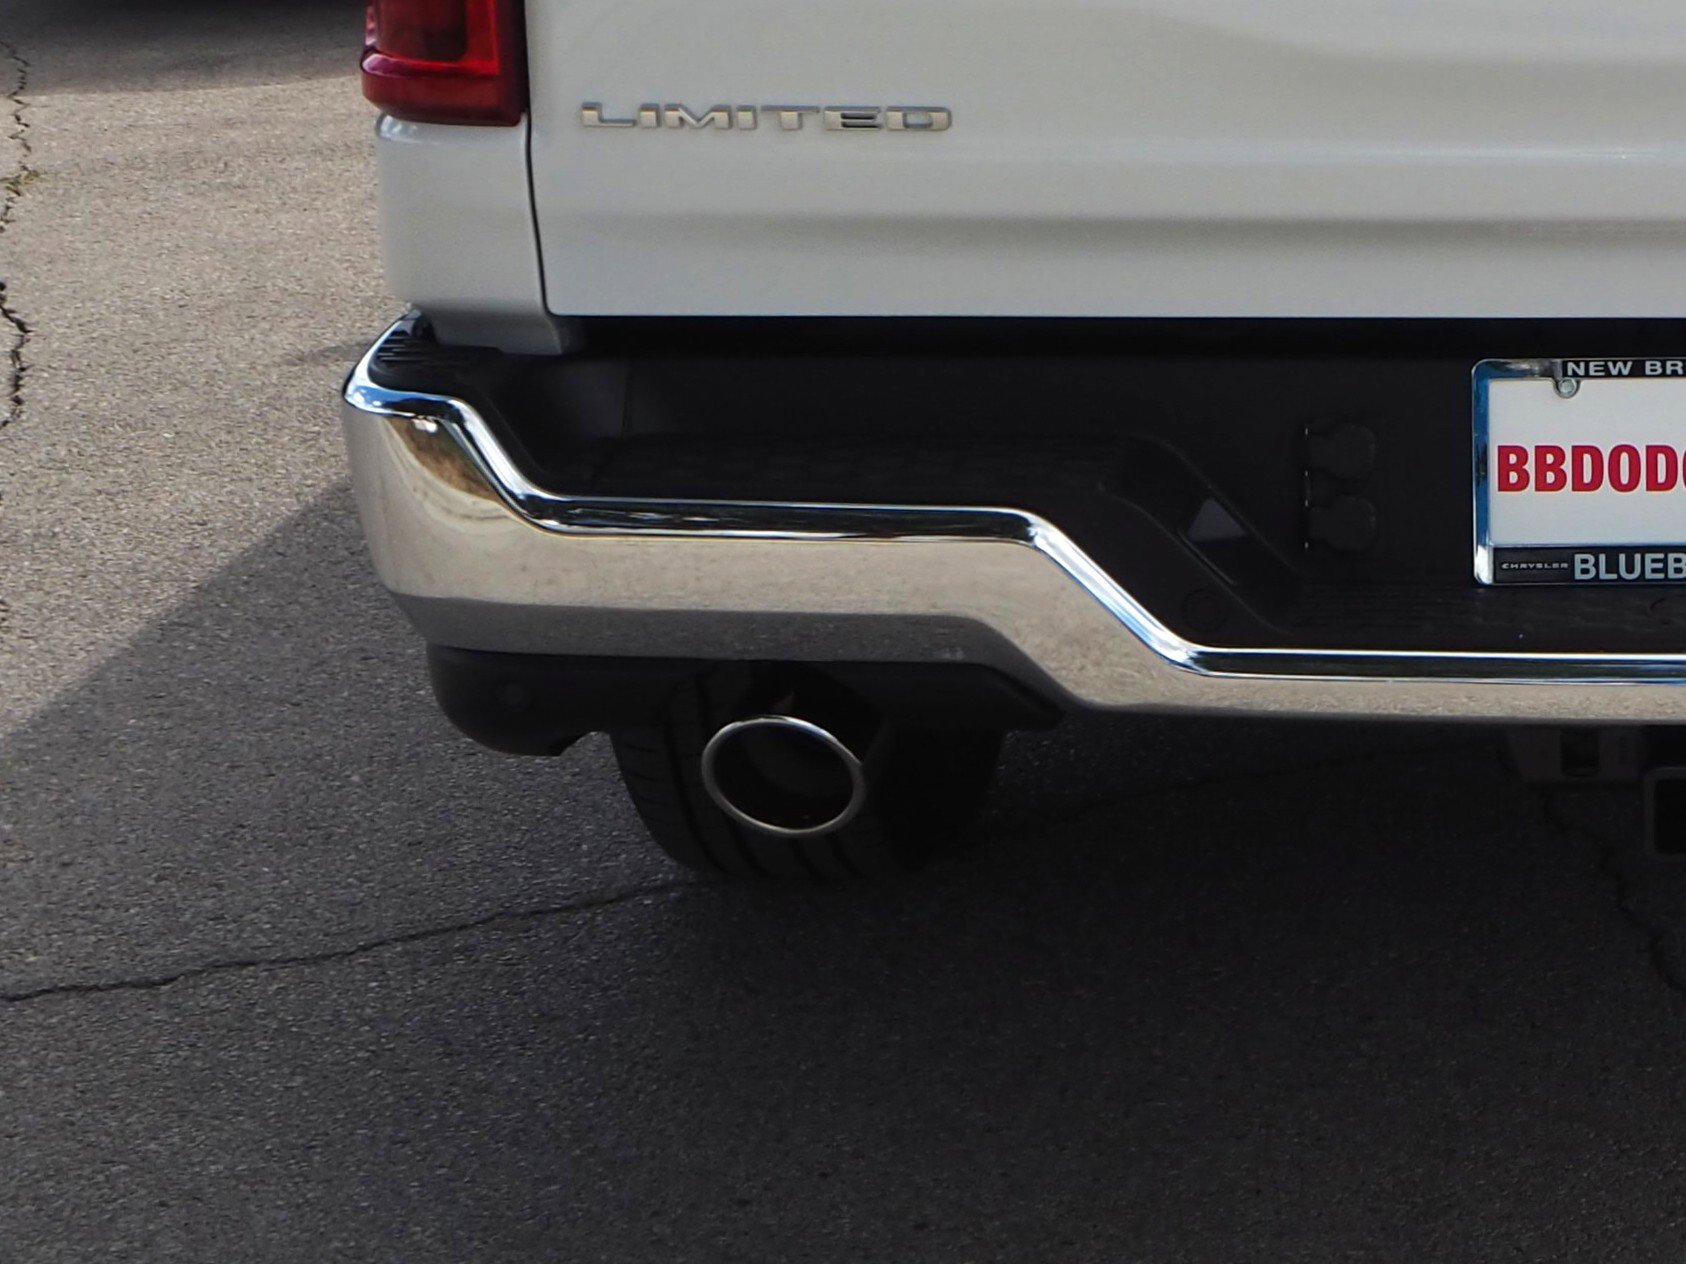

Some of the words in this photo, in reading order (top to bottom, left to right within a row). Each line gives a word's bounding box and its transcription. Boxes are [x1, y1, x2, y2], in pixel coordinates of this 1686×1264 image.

[580, 101, 952, 131] LIMITED
[1566, 361, 1633, 377] NEW
[1501, 562, 1569, 570] CHRYSLER
